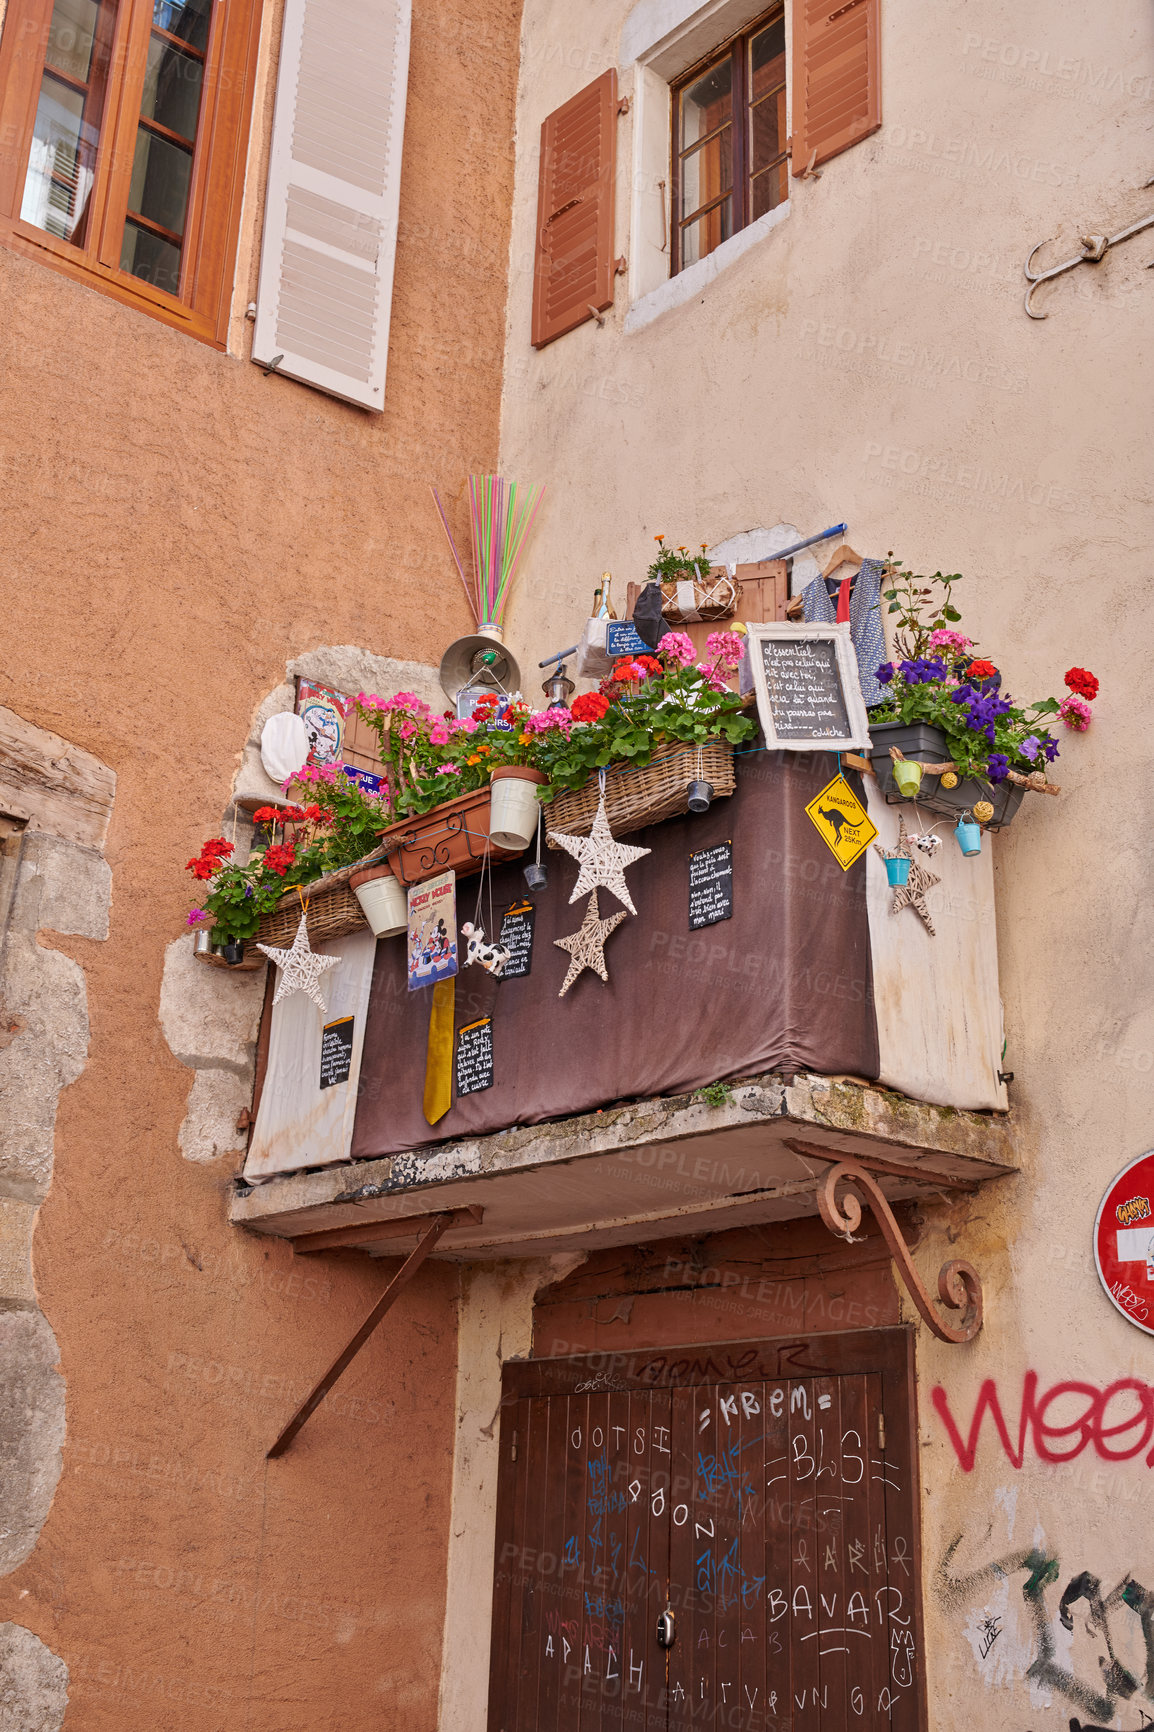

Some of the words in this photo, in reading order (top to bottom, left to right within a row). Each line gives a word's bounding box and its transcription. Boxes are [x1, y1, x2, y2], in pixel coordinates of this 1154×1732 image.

[826, 795, 857, 810] KANGAROOS
[843, 827, 860, 837] NEXT
[410, 892, 431, 907] MICKEY
[431, 883, 453, 900] MOUSE
